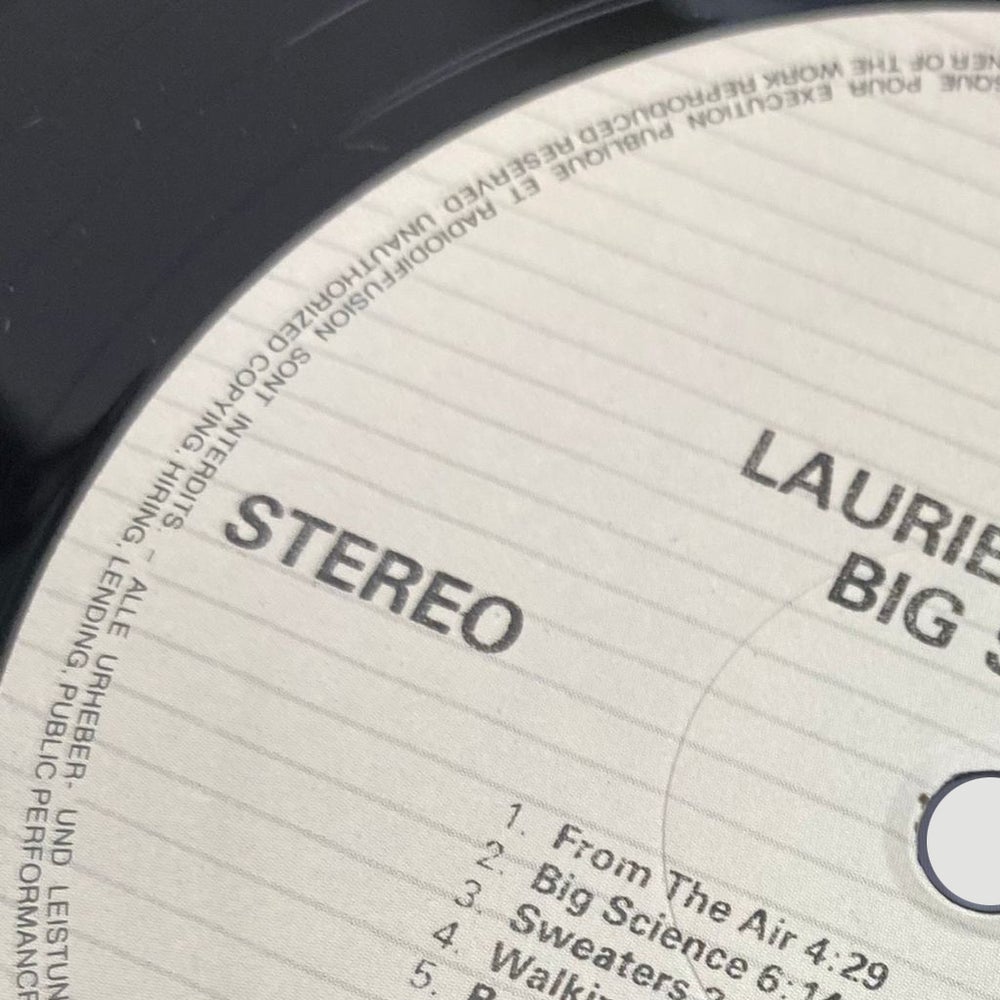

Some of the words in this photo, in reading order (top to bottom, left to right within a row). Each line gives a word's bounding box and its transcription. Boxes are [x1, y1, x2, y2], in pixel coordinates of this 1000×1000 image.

[265, 211, 437, 354] UNAUTHORIZED
[312, 197, 498, 342] RADIODIFFUSION
[253, 345, 311, 405] SONT
[106, 575, 147, 637] ALLE
[222, 493, 524, 654] STEREO
[826, 550, 966, 649] BIG
[33, 682, 80, 780] PUBLIC
[61, 653, 117, 789] URHEBER-
[47, 807, 76, 867] UND
[430, 920, 459, 955] 4.
[451, 877, 483, 916] 3.
[474, 839, 506, 876] 2.
[529, 861, 596, 918] Big
[600, 894, 749, 980] Science
[505, 801, 526, 837] 1.
[551, 822, 652, 889] From
[665, 868, 732, 924] The
[736, 907, 798, 951] Air
[803, 937, 890, 991] 4:29
[408, 957, 438, 996] 5.
